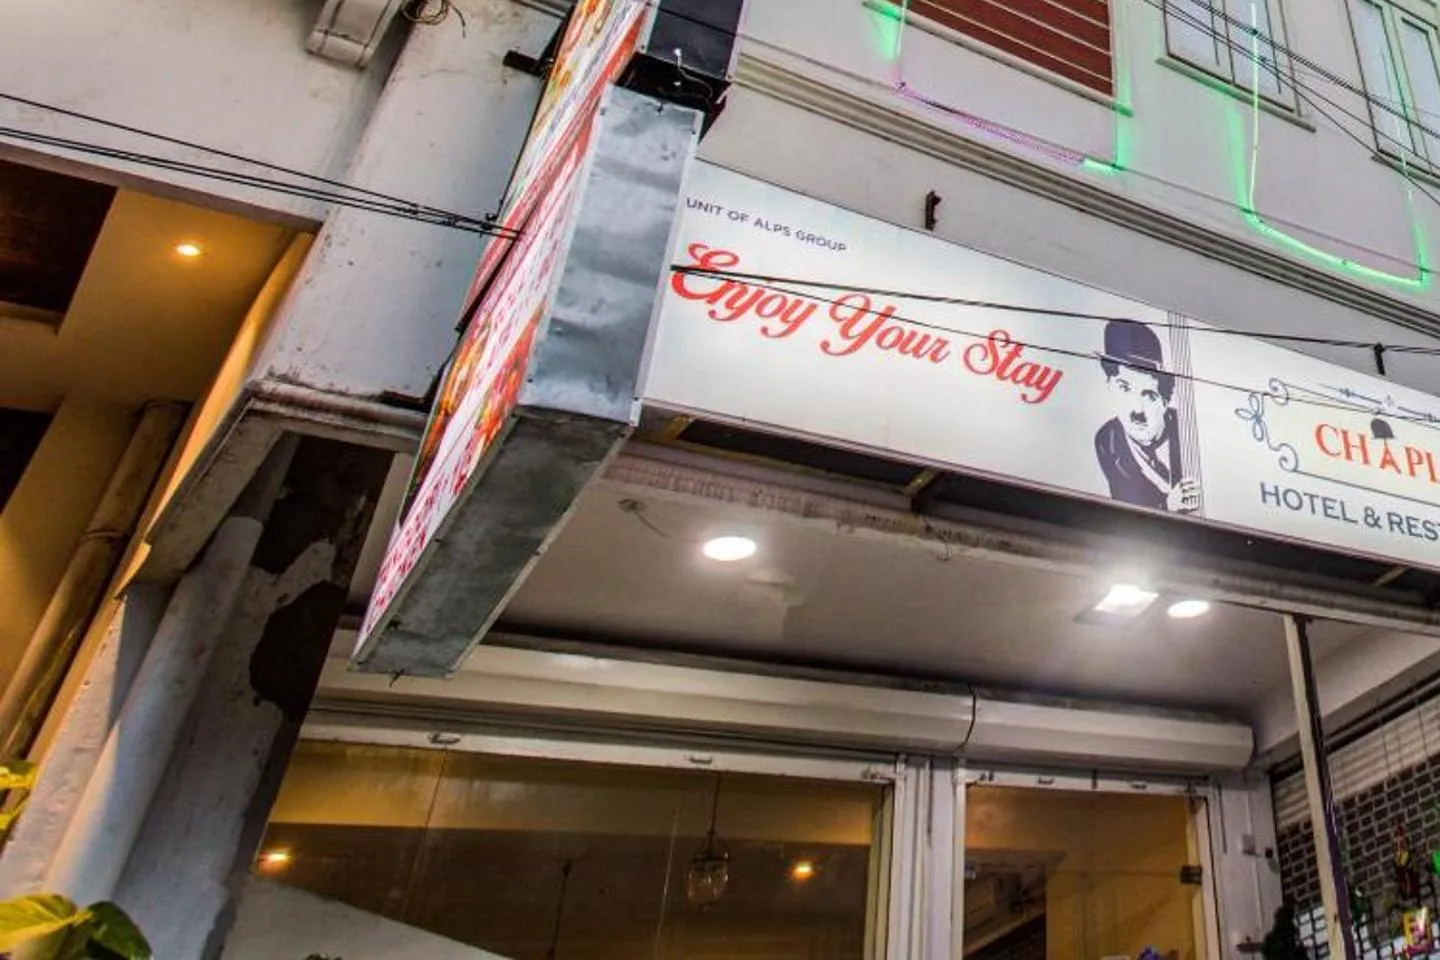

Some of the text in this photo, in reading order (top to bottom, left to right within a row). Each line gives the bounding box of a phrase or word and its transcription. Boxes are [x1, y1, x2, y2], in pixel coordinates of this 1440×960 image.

[686, 197, 848, 252] UNIT OF ALPS GROUP
[671, 243, 1064, 404] Enjoy Your Stay
[1260, 482, 1357, 525] HOTEL
[1364, 506, 1382, 529] &
